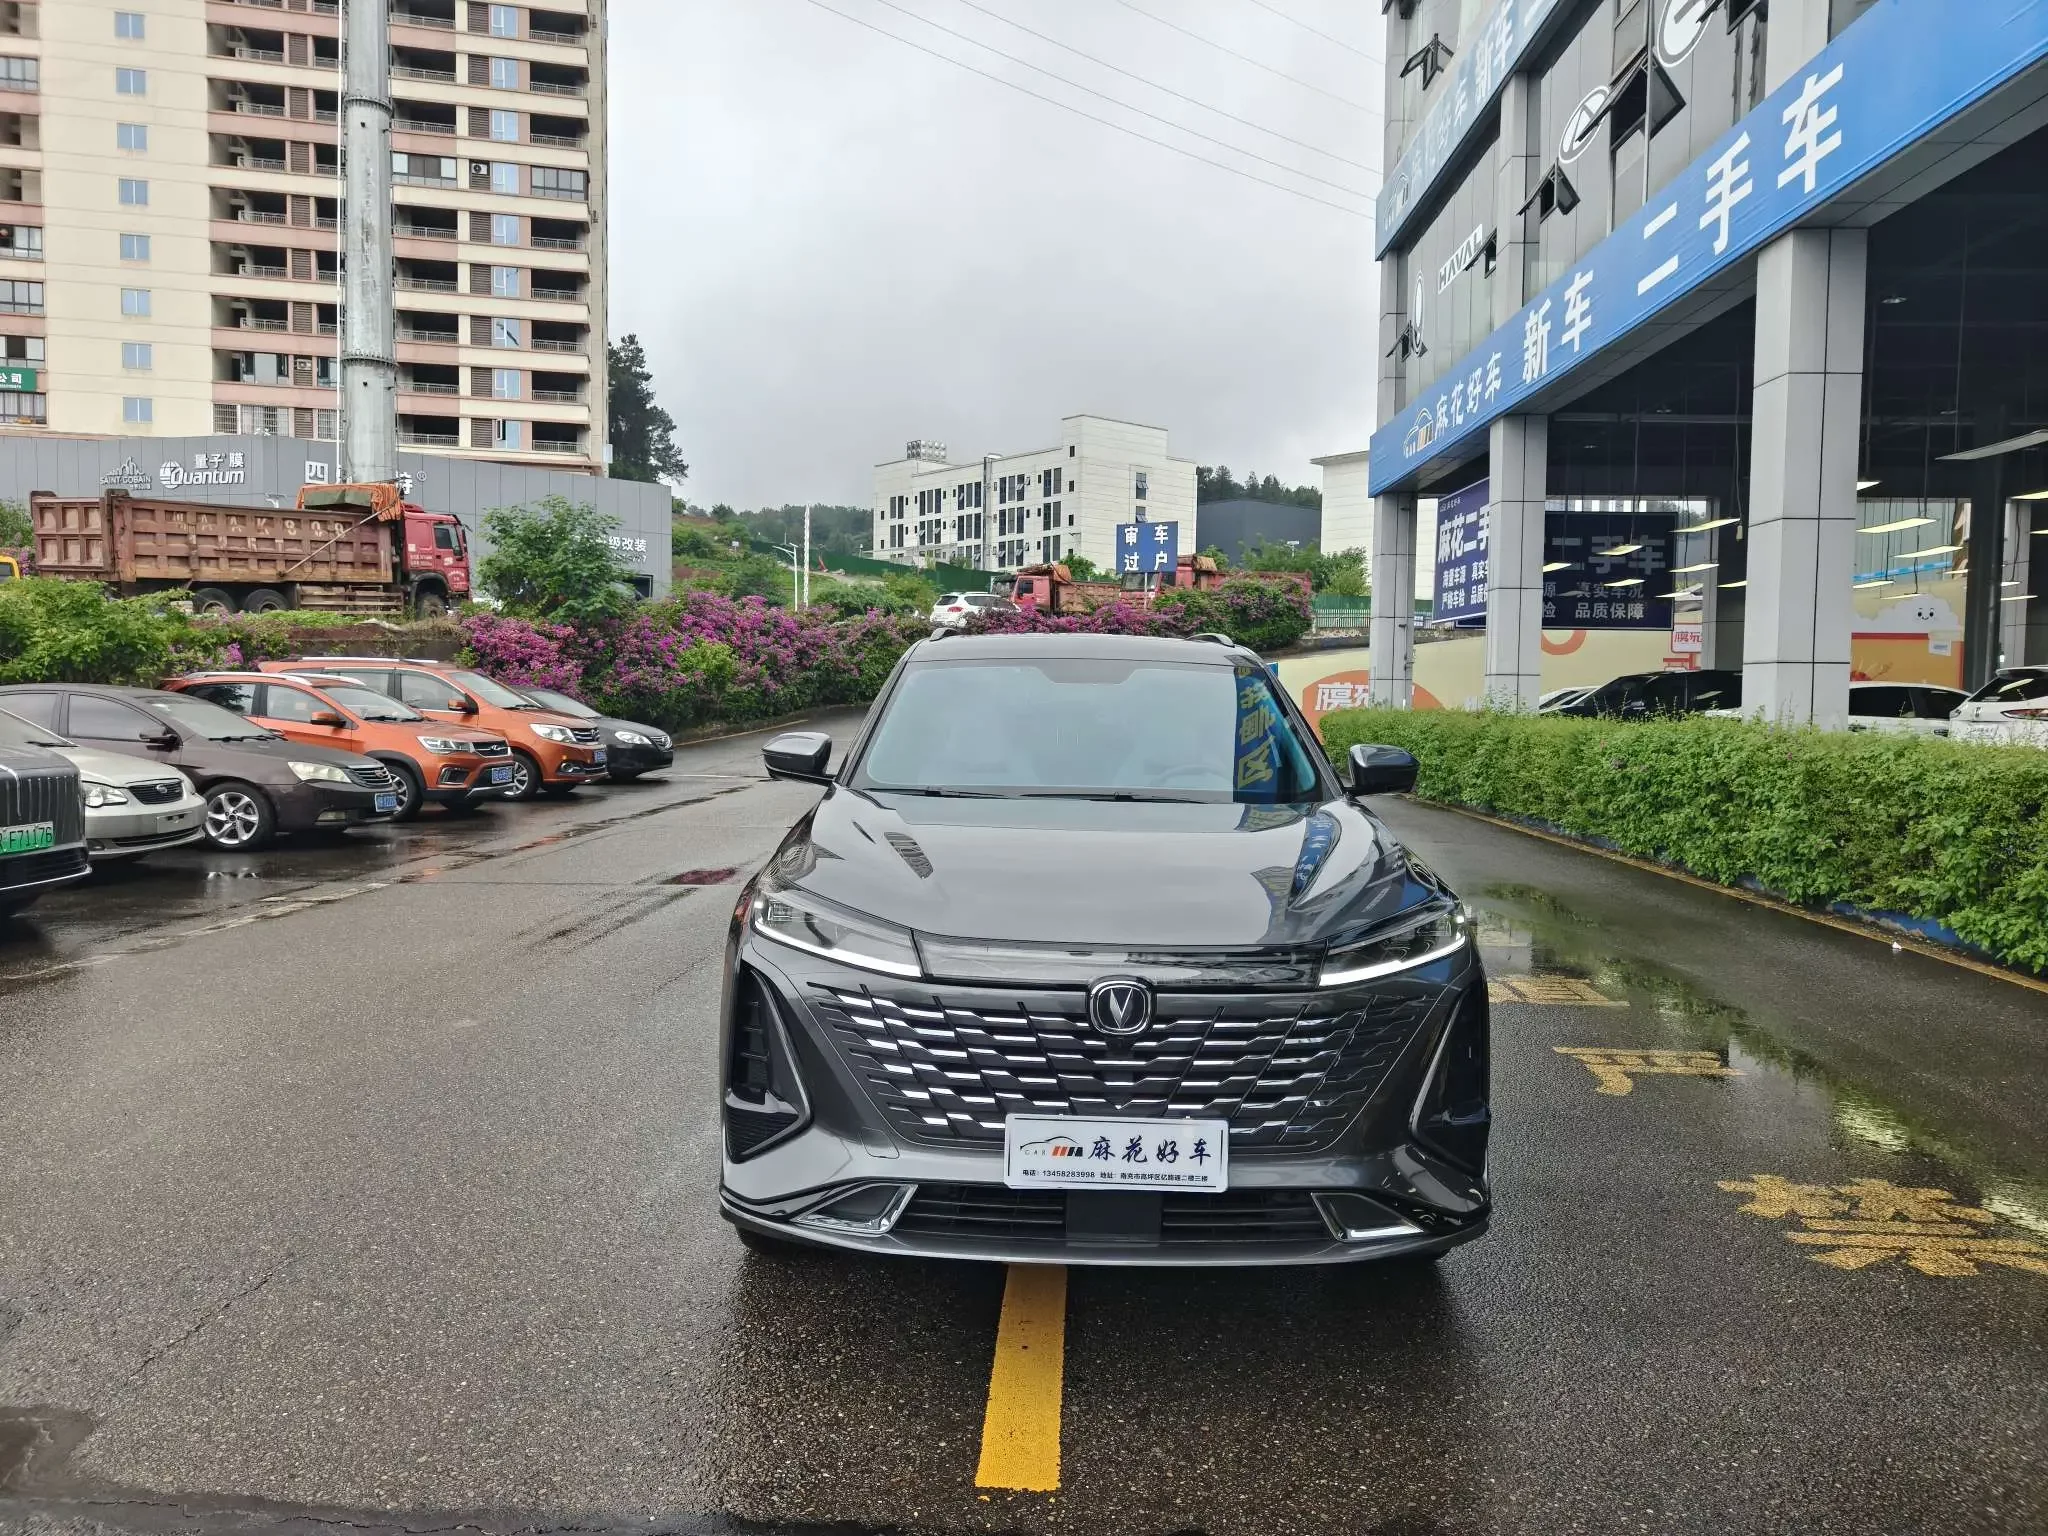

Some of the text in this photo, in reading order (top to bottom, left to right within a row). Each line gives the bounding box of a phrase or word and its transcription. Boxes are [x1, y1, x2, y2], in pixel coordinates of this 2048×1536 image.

[1435, 62, 1843, 441] 麻花好车 新车 二手车
[1438, 224, 1483, 295] HAVAL
[171, 466, 245, 485] Quantum
[1576, 581, 1645, 599] 真实车况
[1575, 602, 1645, 620] 品质保障
[1088, 1135, 1212, 1167] 麻花好车
